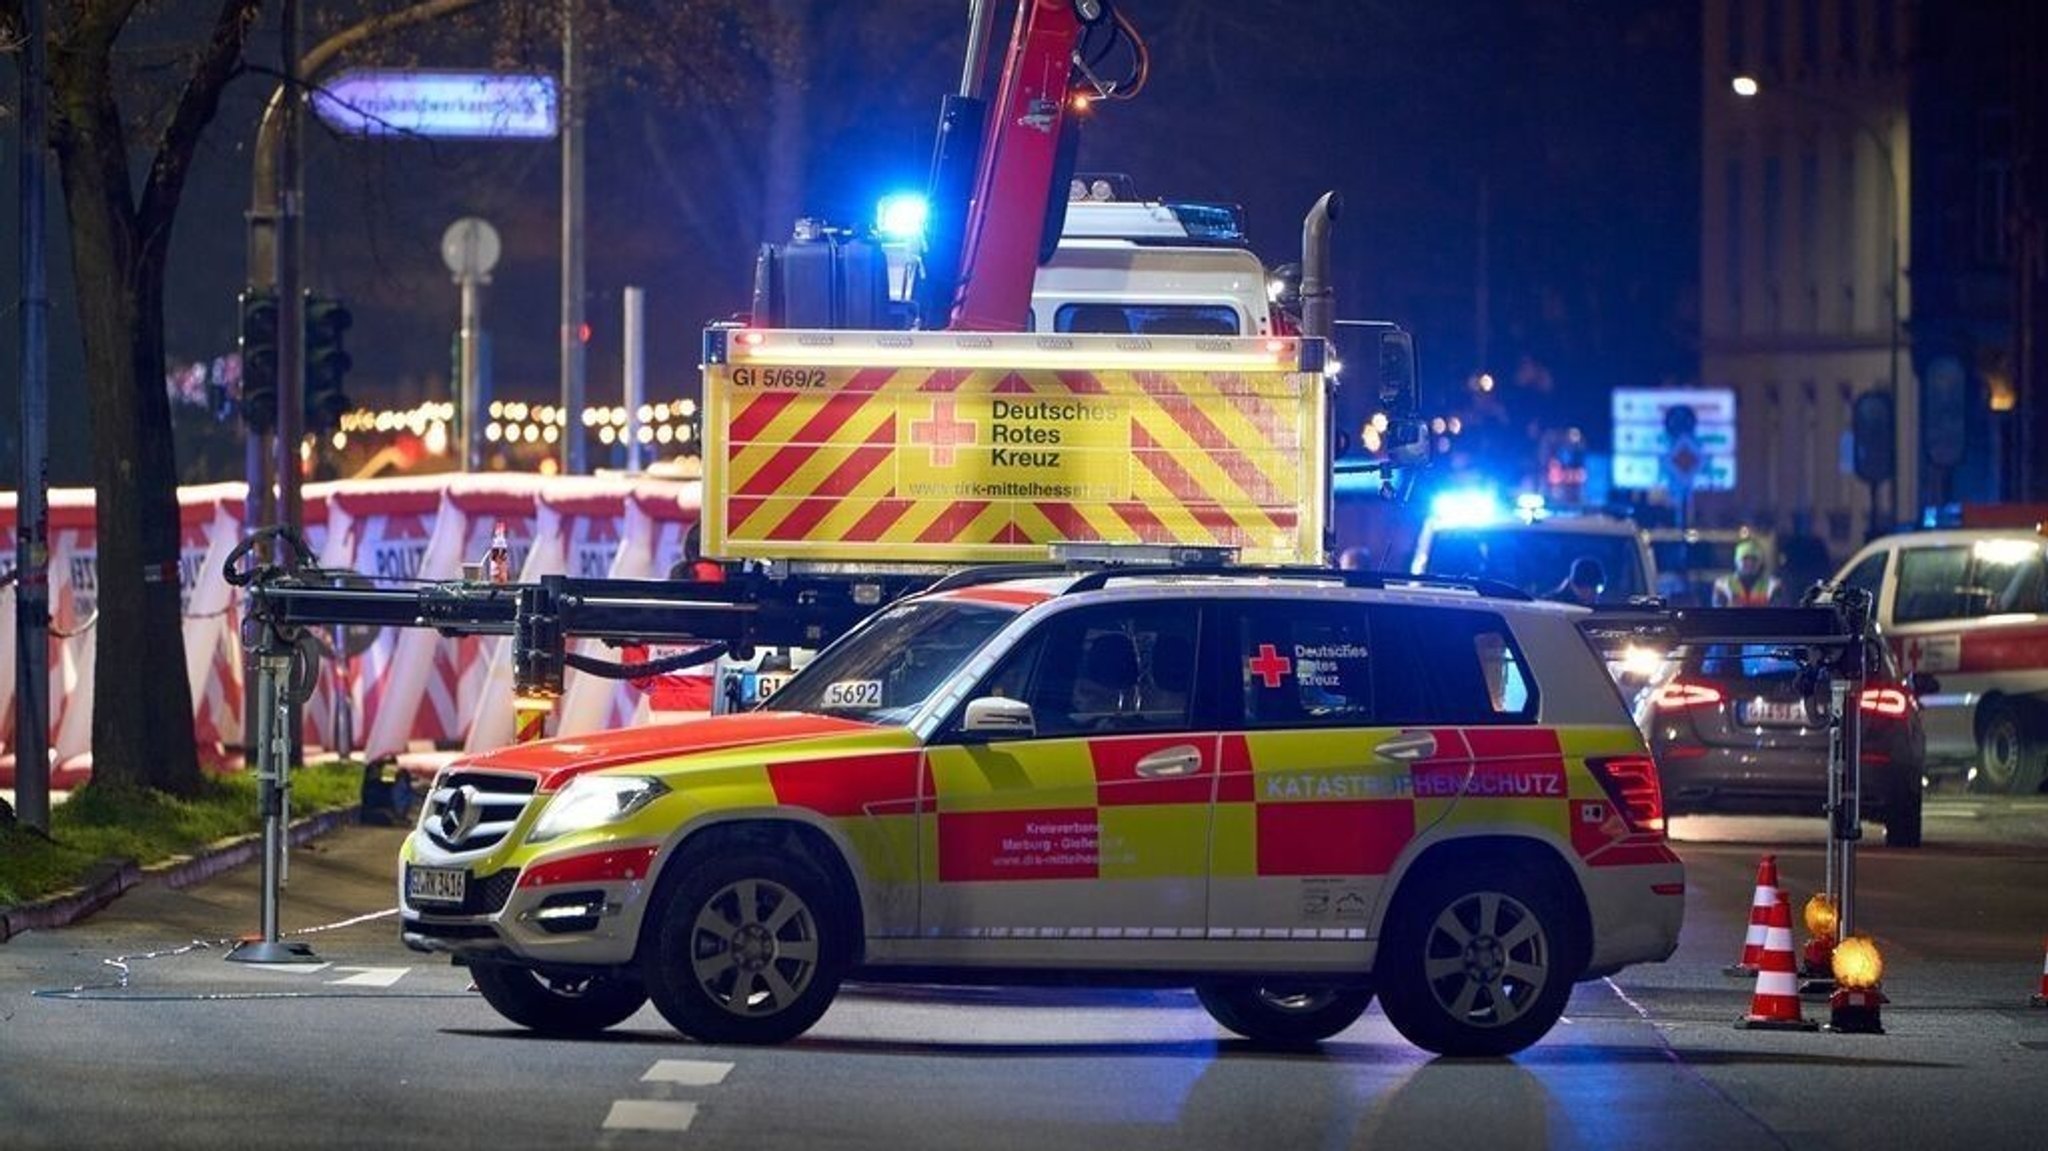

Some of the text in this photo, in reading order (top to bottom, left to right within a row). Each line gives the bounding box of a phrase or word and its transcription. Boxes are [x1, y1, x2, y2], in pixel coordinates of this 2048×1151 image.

[732, 368, 826, 388] GI 5/69/2
[991, 400, 1118, 421] Deutsches
[992, 424, 1061, 444] Rotes
[991, 447, 1061, 468] Kreuz
[1294, 644, 1368, 658] Deutsches
[831, 681, 879, 705] 5692
[1266, 774, 1560, 795] KATASTRPHENSCHUTZ
